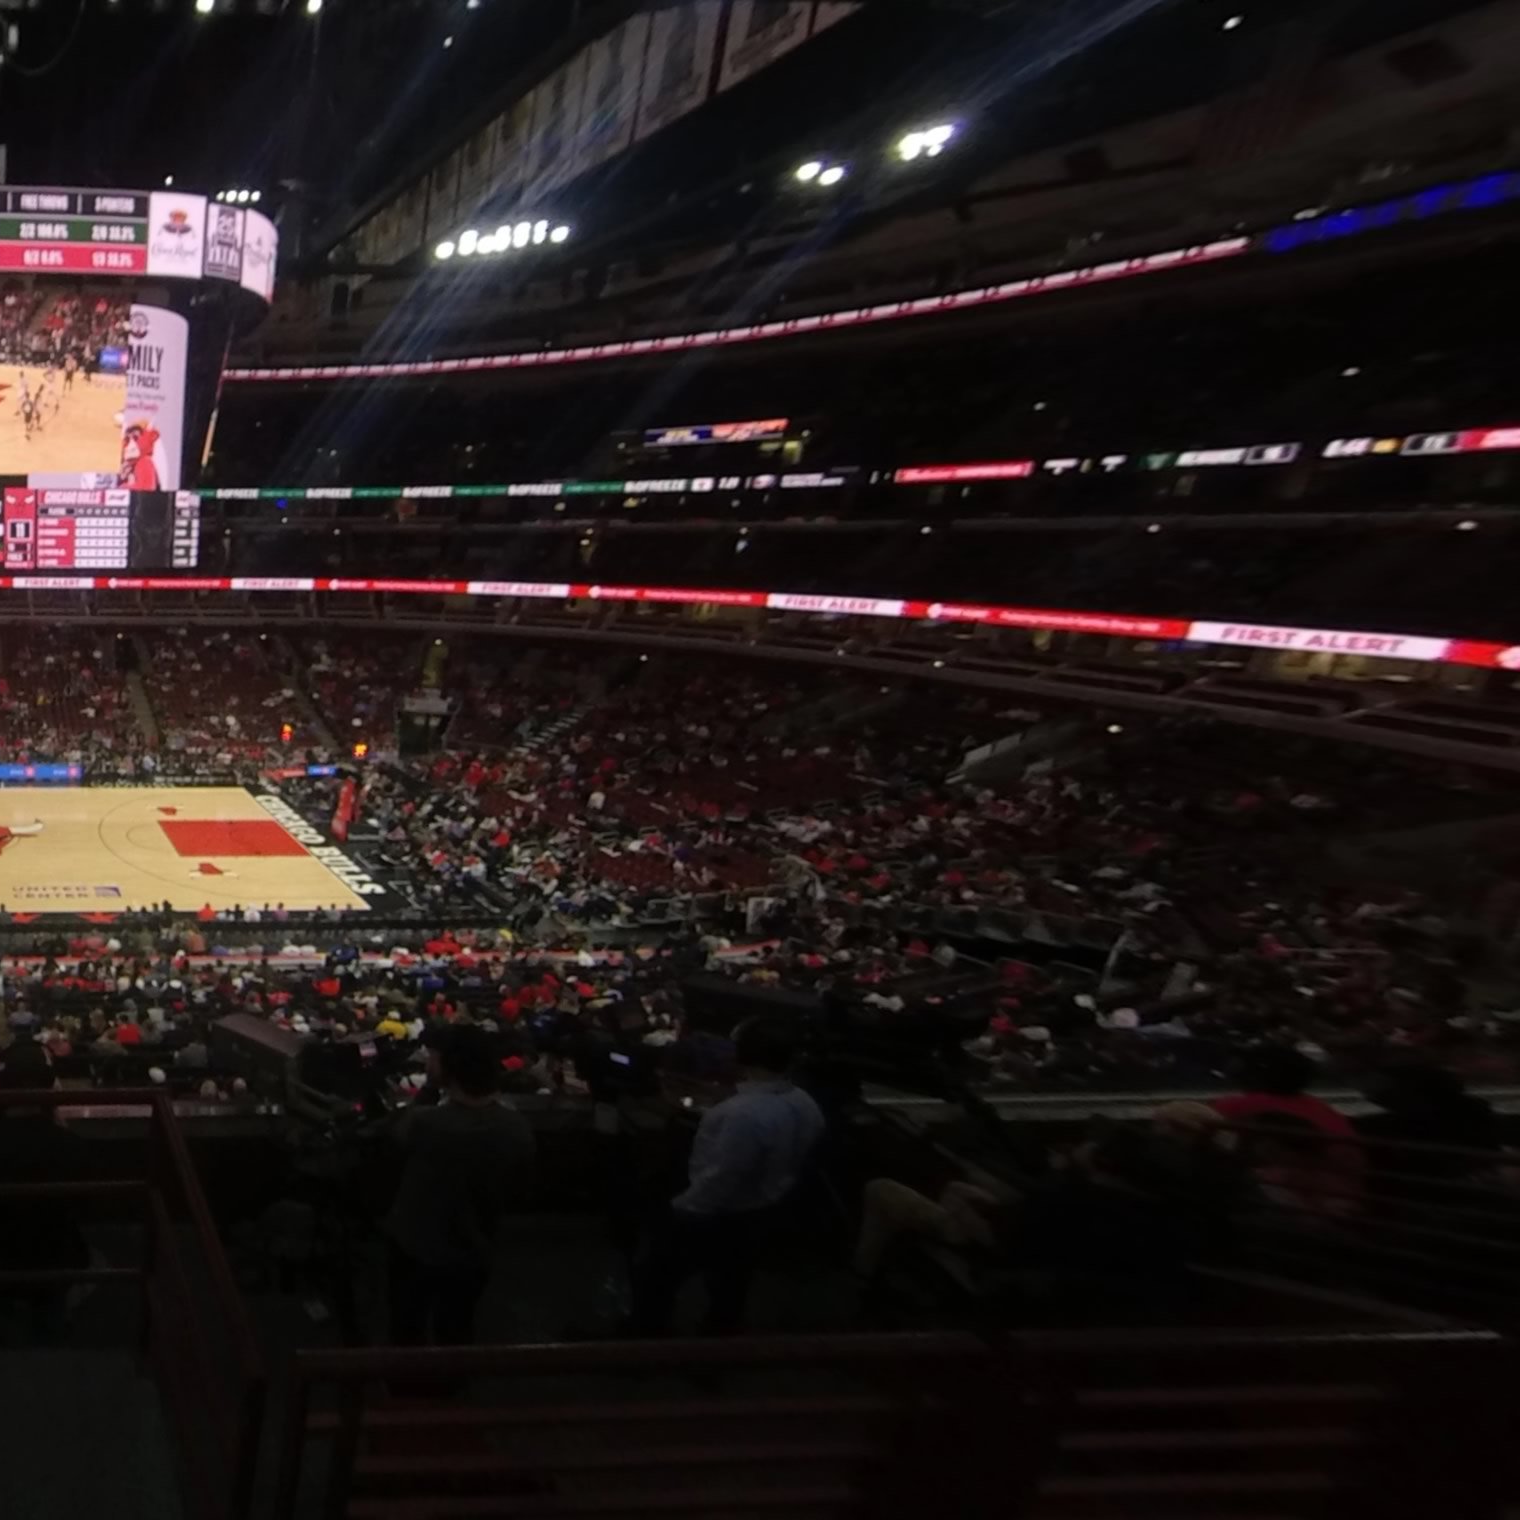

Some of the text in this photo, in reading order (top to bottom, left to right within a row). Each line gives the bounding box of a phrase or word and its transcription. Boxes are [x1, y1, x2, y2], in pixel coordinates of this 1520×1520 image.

[24, 578, 80, 586] FIRST ALERT
[243, 579, 300, 588] FIRST ALERT
[482, 584, 551, 593] FIRST ALERT
[785, 597, 878, 611] FIRST ALERT
[1221, 626, 1406, 653] FIRST ALERT
[255, 794, 326, 844] CHICAGO
[308, 846, 387, 894] BULLS
